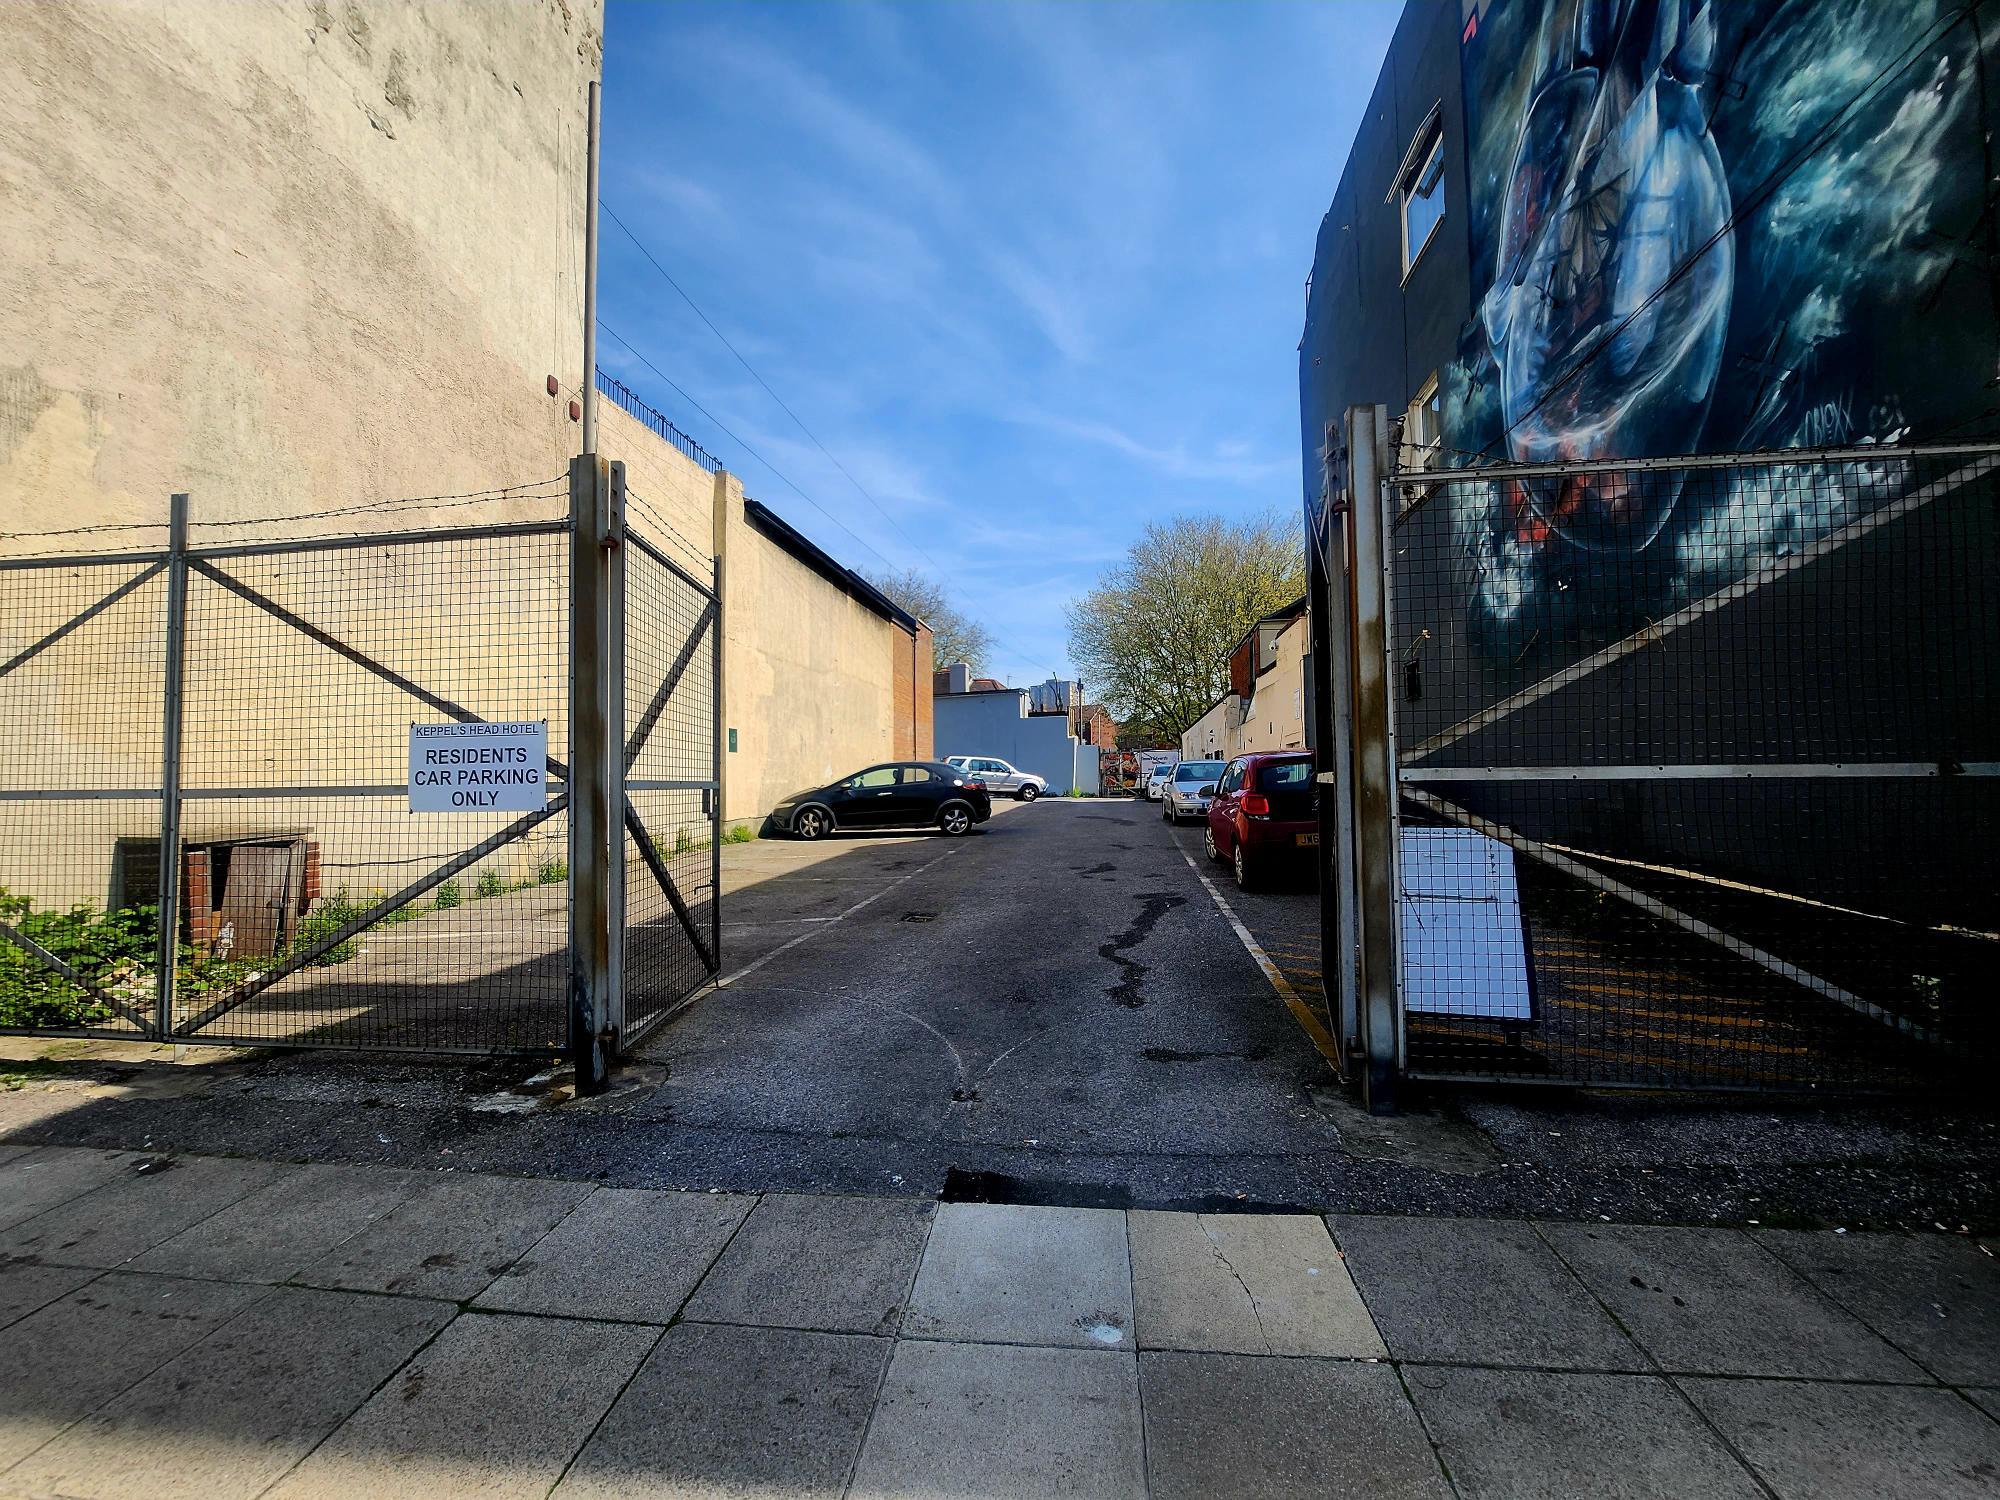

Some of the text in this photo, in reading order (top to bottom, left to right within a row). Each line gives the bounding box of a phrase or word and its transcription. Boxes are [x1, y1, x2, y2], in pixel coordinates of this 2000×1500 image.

[416, 724, 538, 737] KEPPEL'S HEAD HOTEL
[426, 747, 527, 765] RESIDENTS
[415, 769, 539, 786] CAR PARKING
[451, 791, 500, 807] ONLY
